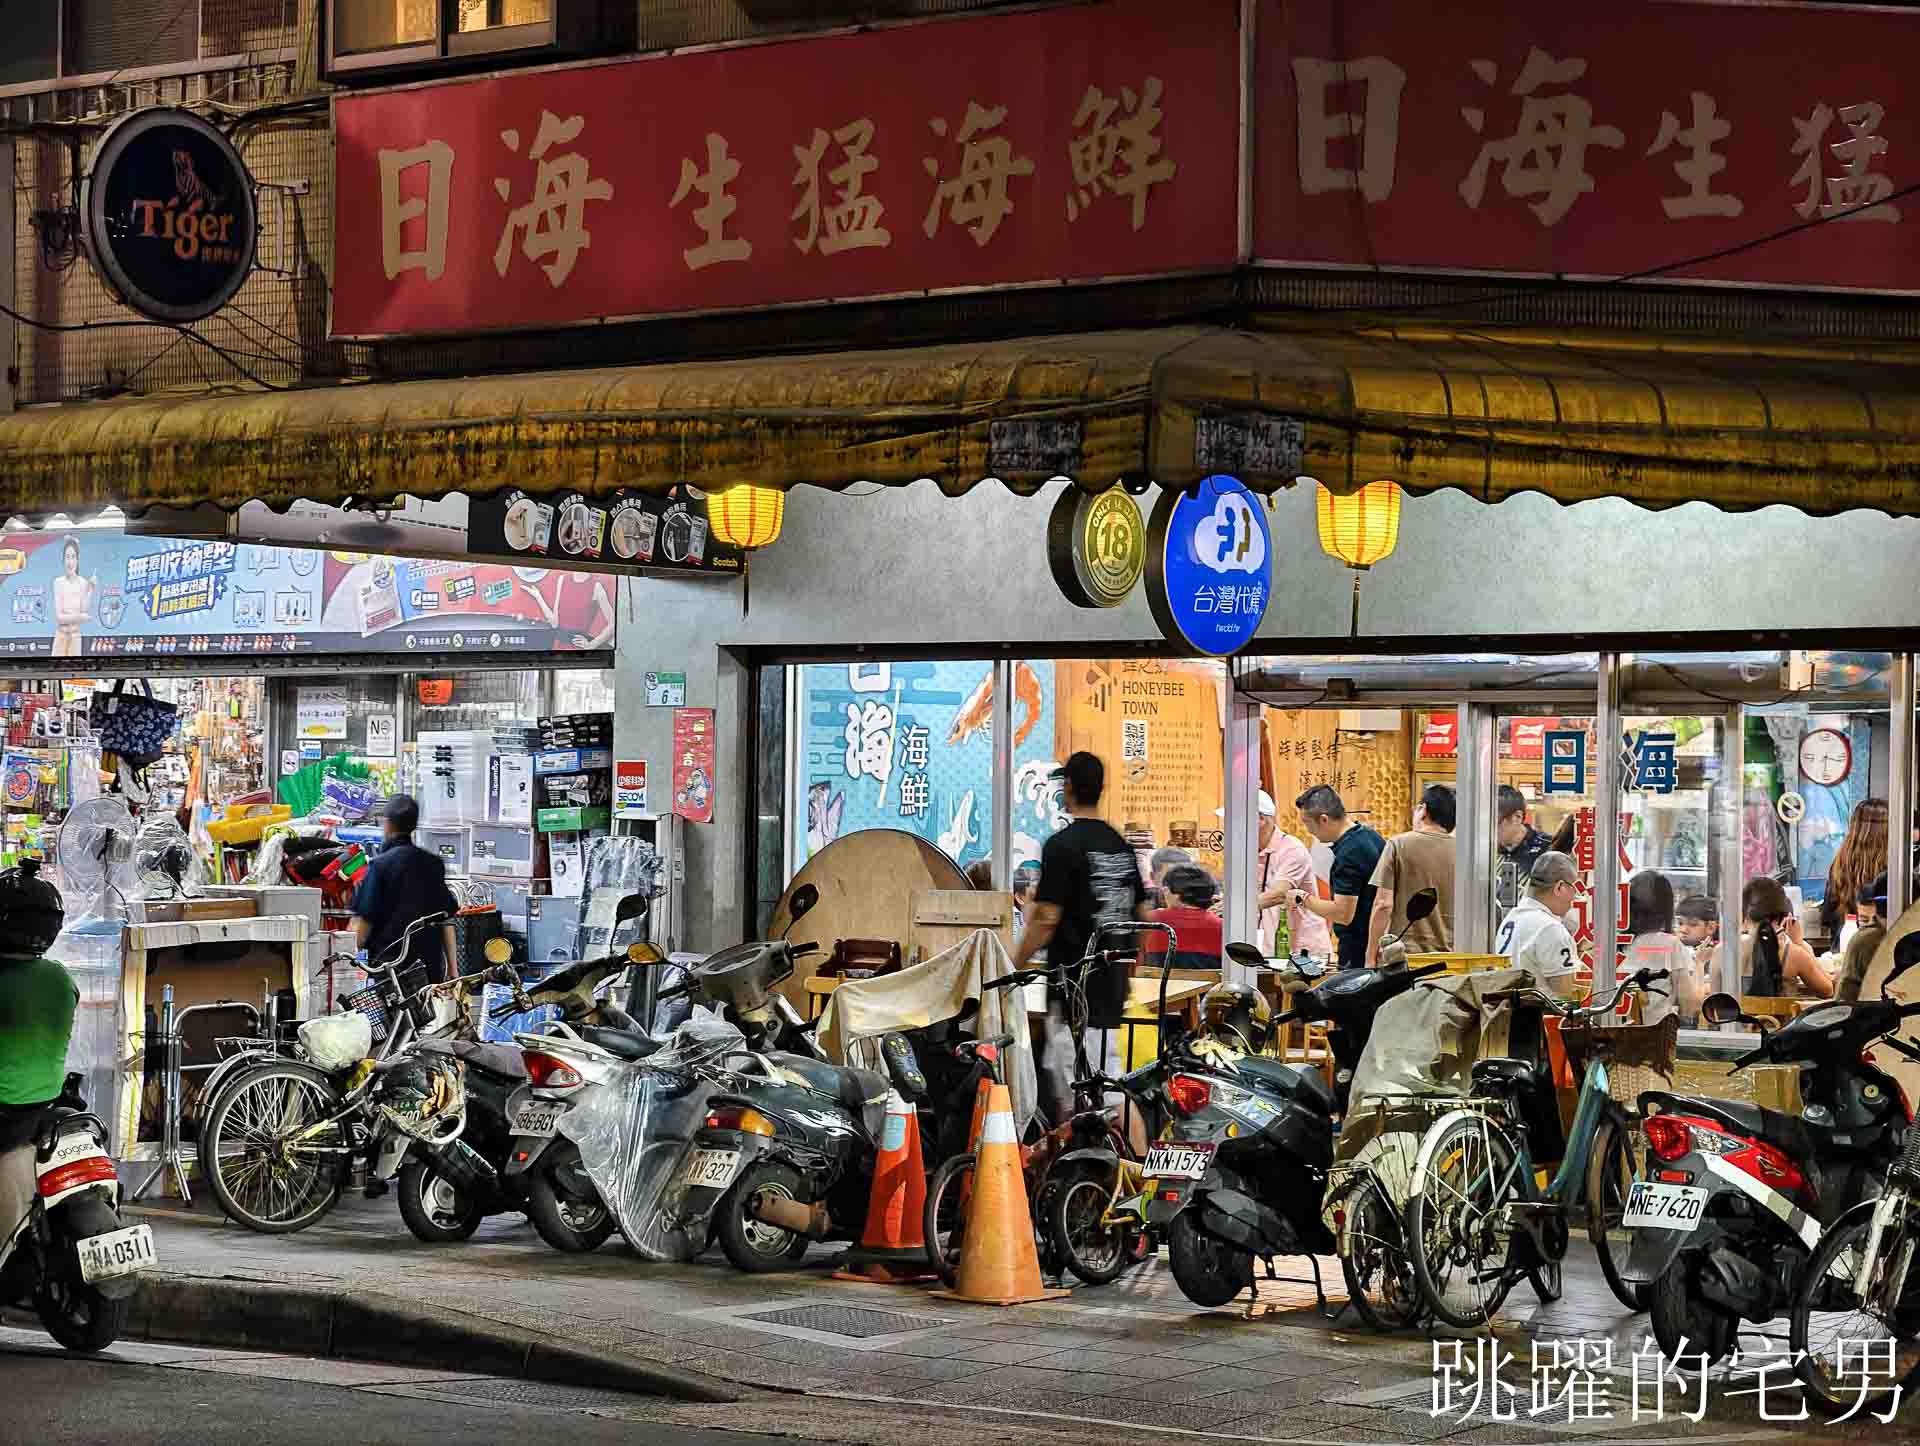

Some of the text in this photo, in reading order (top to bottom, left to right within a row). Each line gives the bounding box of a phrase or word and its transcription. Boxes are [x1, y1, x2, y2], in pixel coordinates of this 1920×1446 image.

[1290, 46, 1903, 225] 日海生猛
[376, 77, 1177, 288] 日海生猛海鮮
[132, 198, 234, 260] Tiger
[1101, 522, 1129, 561] 18
[712, 556, 739, 568] Scotch
[1122, 680, 1185, 697] HONEYBEE
[1121, 701, 1159, 715] TOWN
[899, 722, 929, 819] 海鮮
[618, 792, 644, 802] SECOM
[1561, 948, 1573, 967] 2
[1145, 1151, 1209, 1171] NKN-1573
